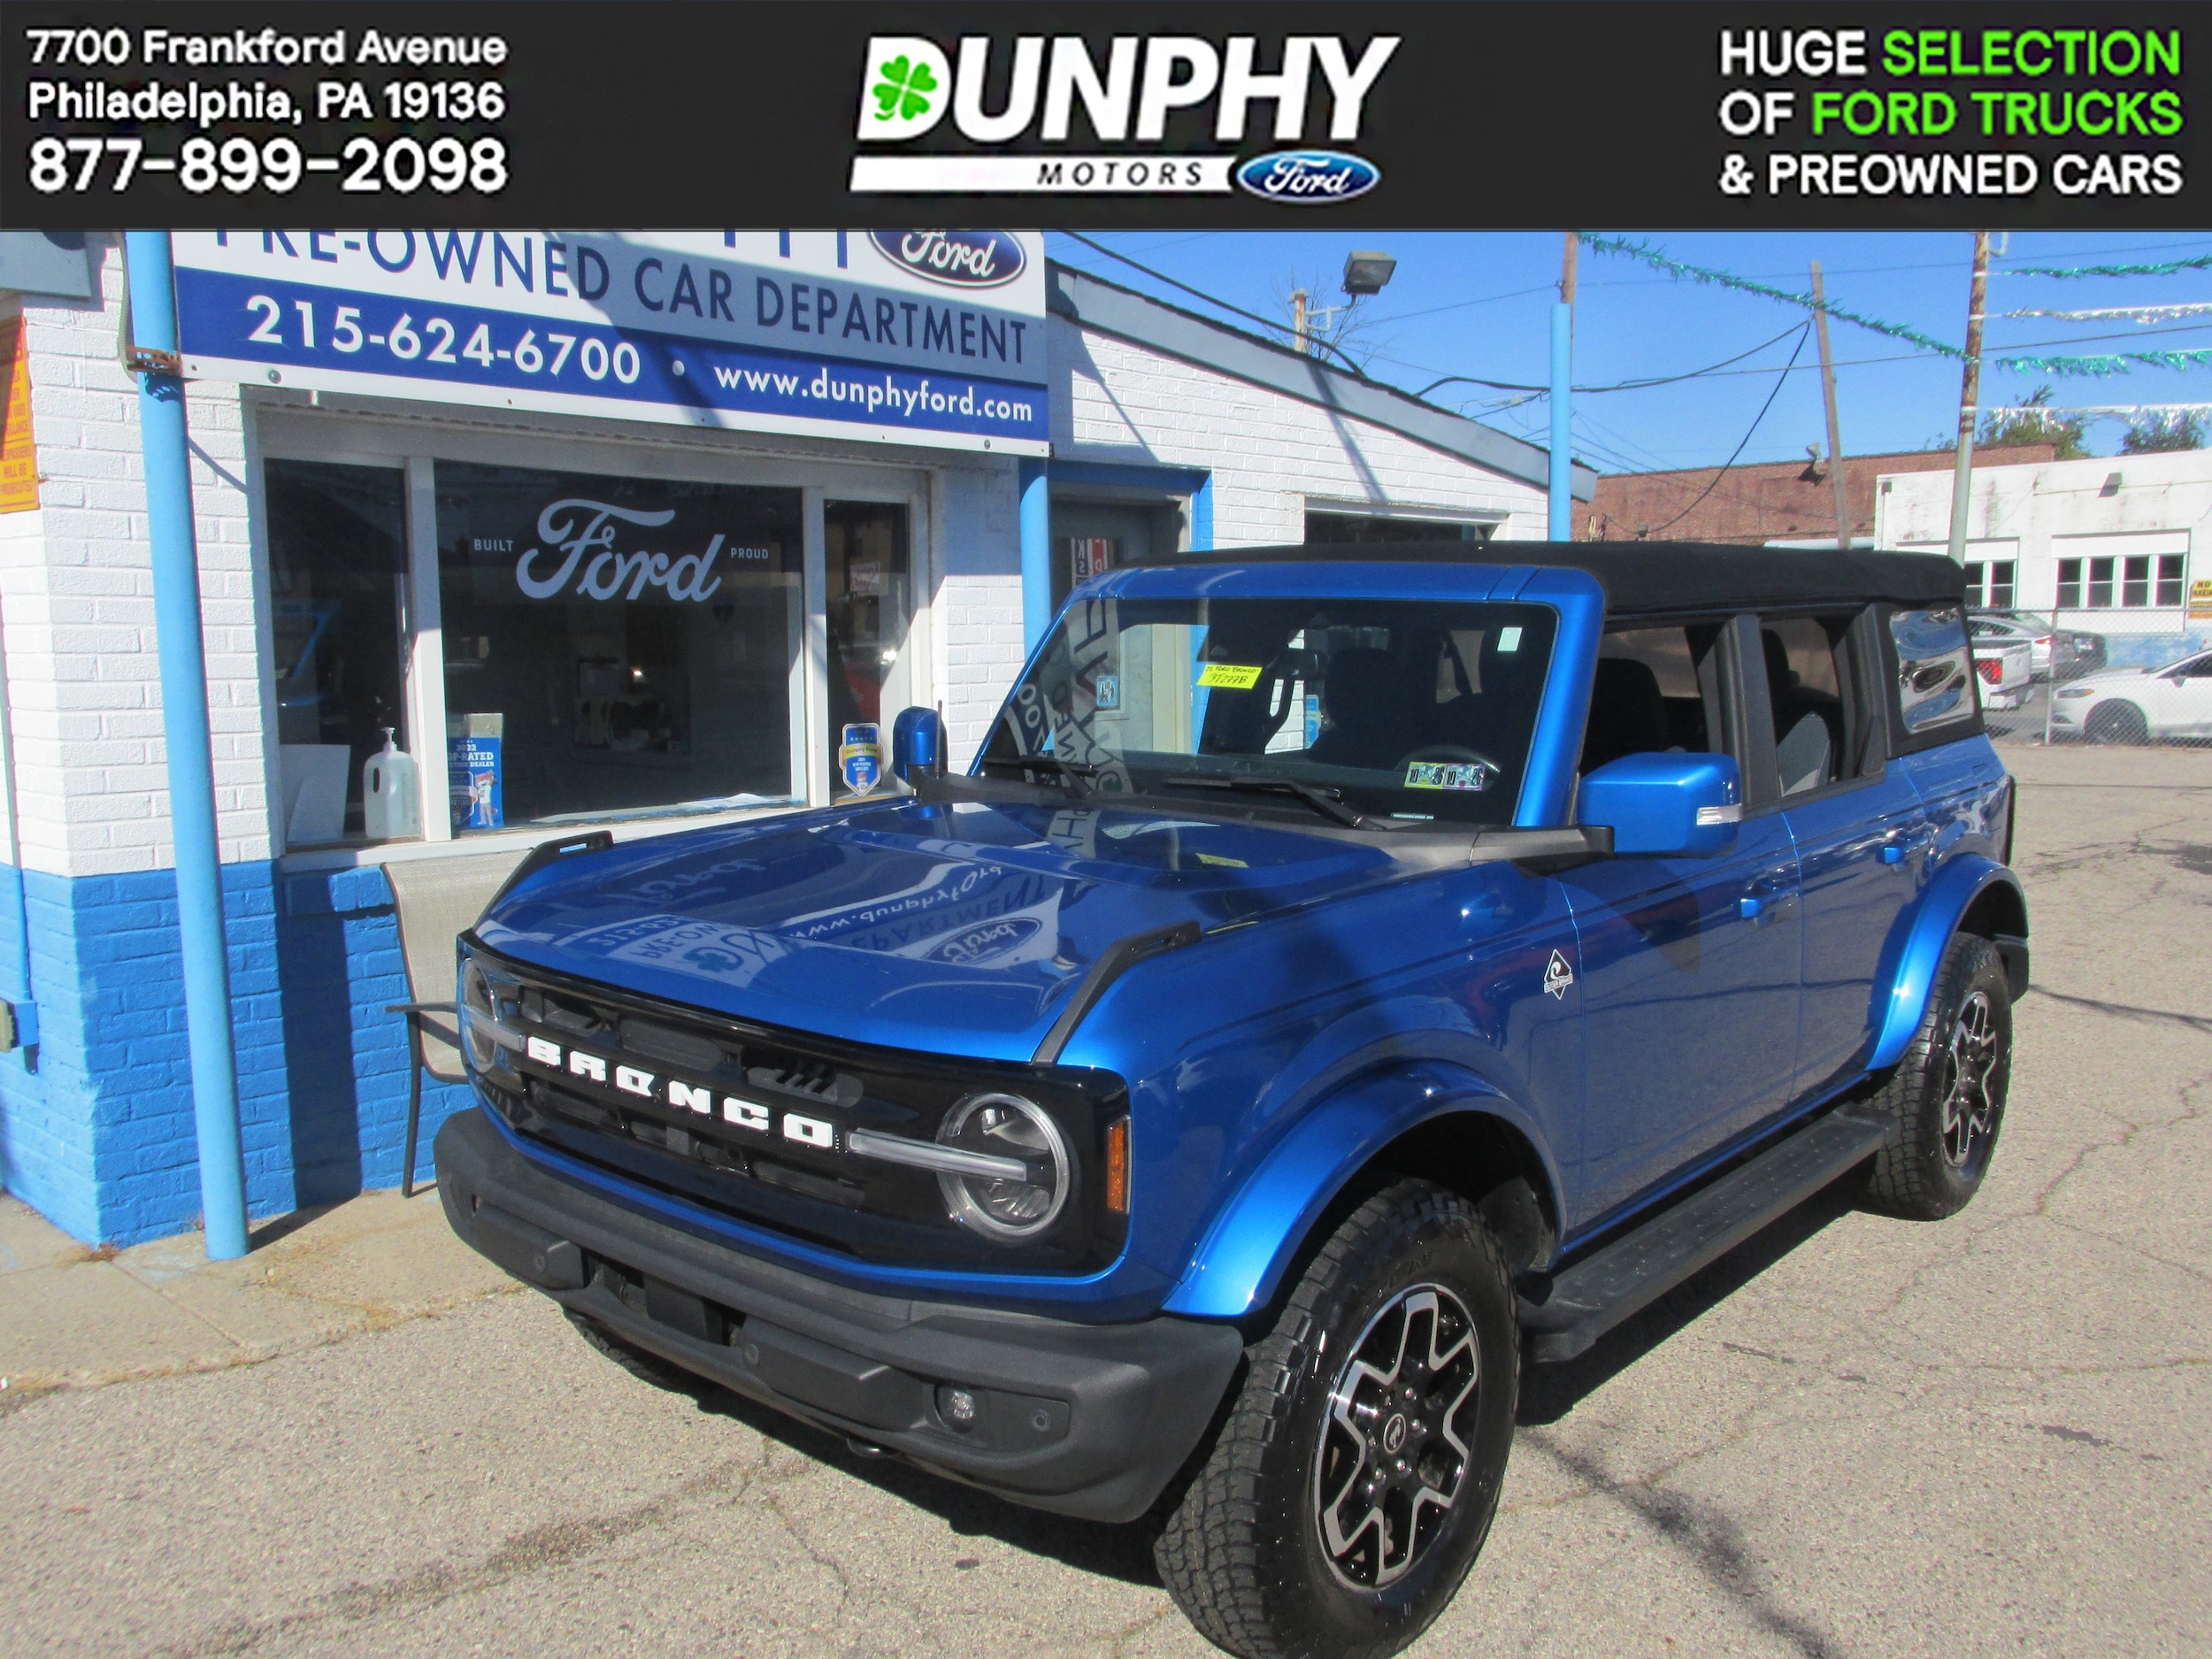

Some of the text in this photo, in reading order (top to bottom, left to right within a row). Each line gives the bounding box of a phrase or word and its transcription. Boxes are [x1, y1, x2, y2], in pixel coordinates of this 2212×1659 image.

[245, 294, 1033, 423] 215-624-6700 www.dunphyford.com
[634, 257, 735, 322] CAR
[757, 277, 1026, 365] DEPARTMENT
[473, 498, 769, 603] BUILT Ford PROUD
[527, 1035, 833, 1148] BRONCO
